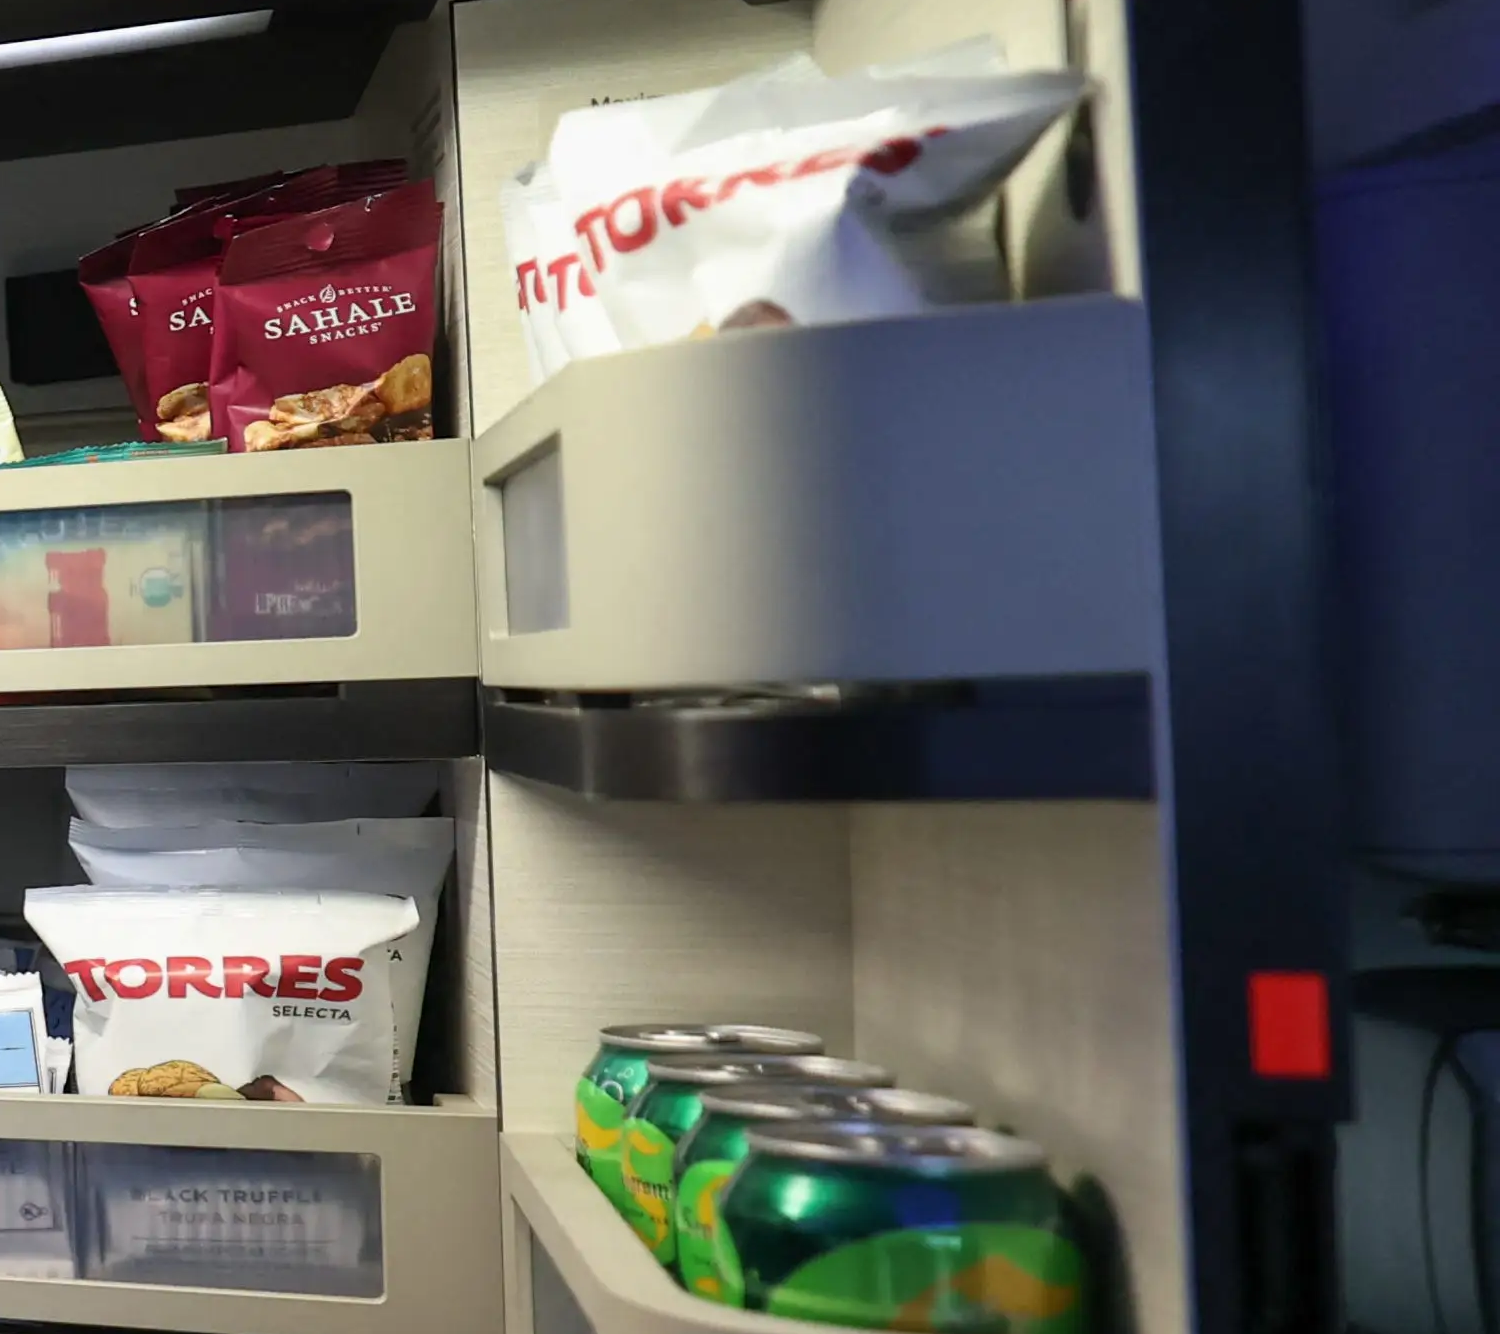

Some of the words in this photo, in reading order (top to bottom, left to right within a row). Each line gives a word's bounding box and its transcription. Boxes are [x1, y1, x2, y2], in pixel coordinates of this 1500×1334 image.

[182, 287, 214, 306] SNAC
[277, 294, 317, 313] SNACK
[338, 285, 393, 297] BETTER
[264, 292, 417, 341] SAHALE
[309, 322, 383, 346] SNACKS
[63, 954, 365, 1004] TORRES
[271, 1003, 353, 1022] SELECTA
[217, 1187, 323, 1205] TRUFFLE
